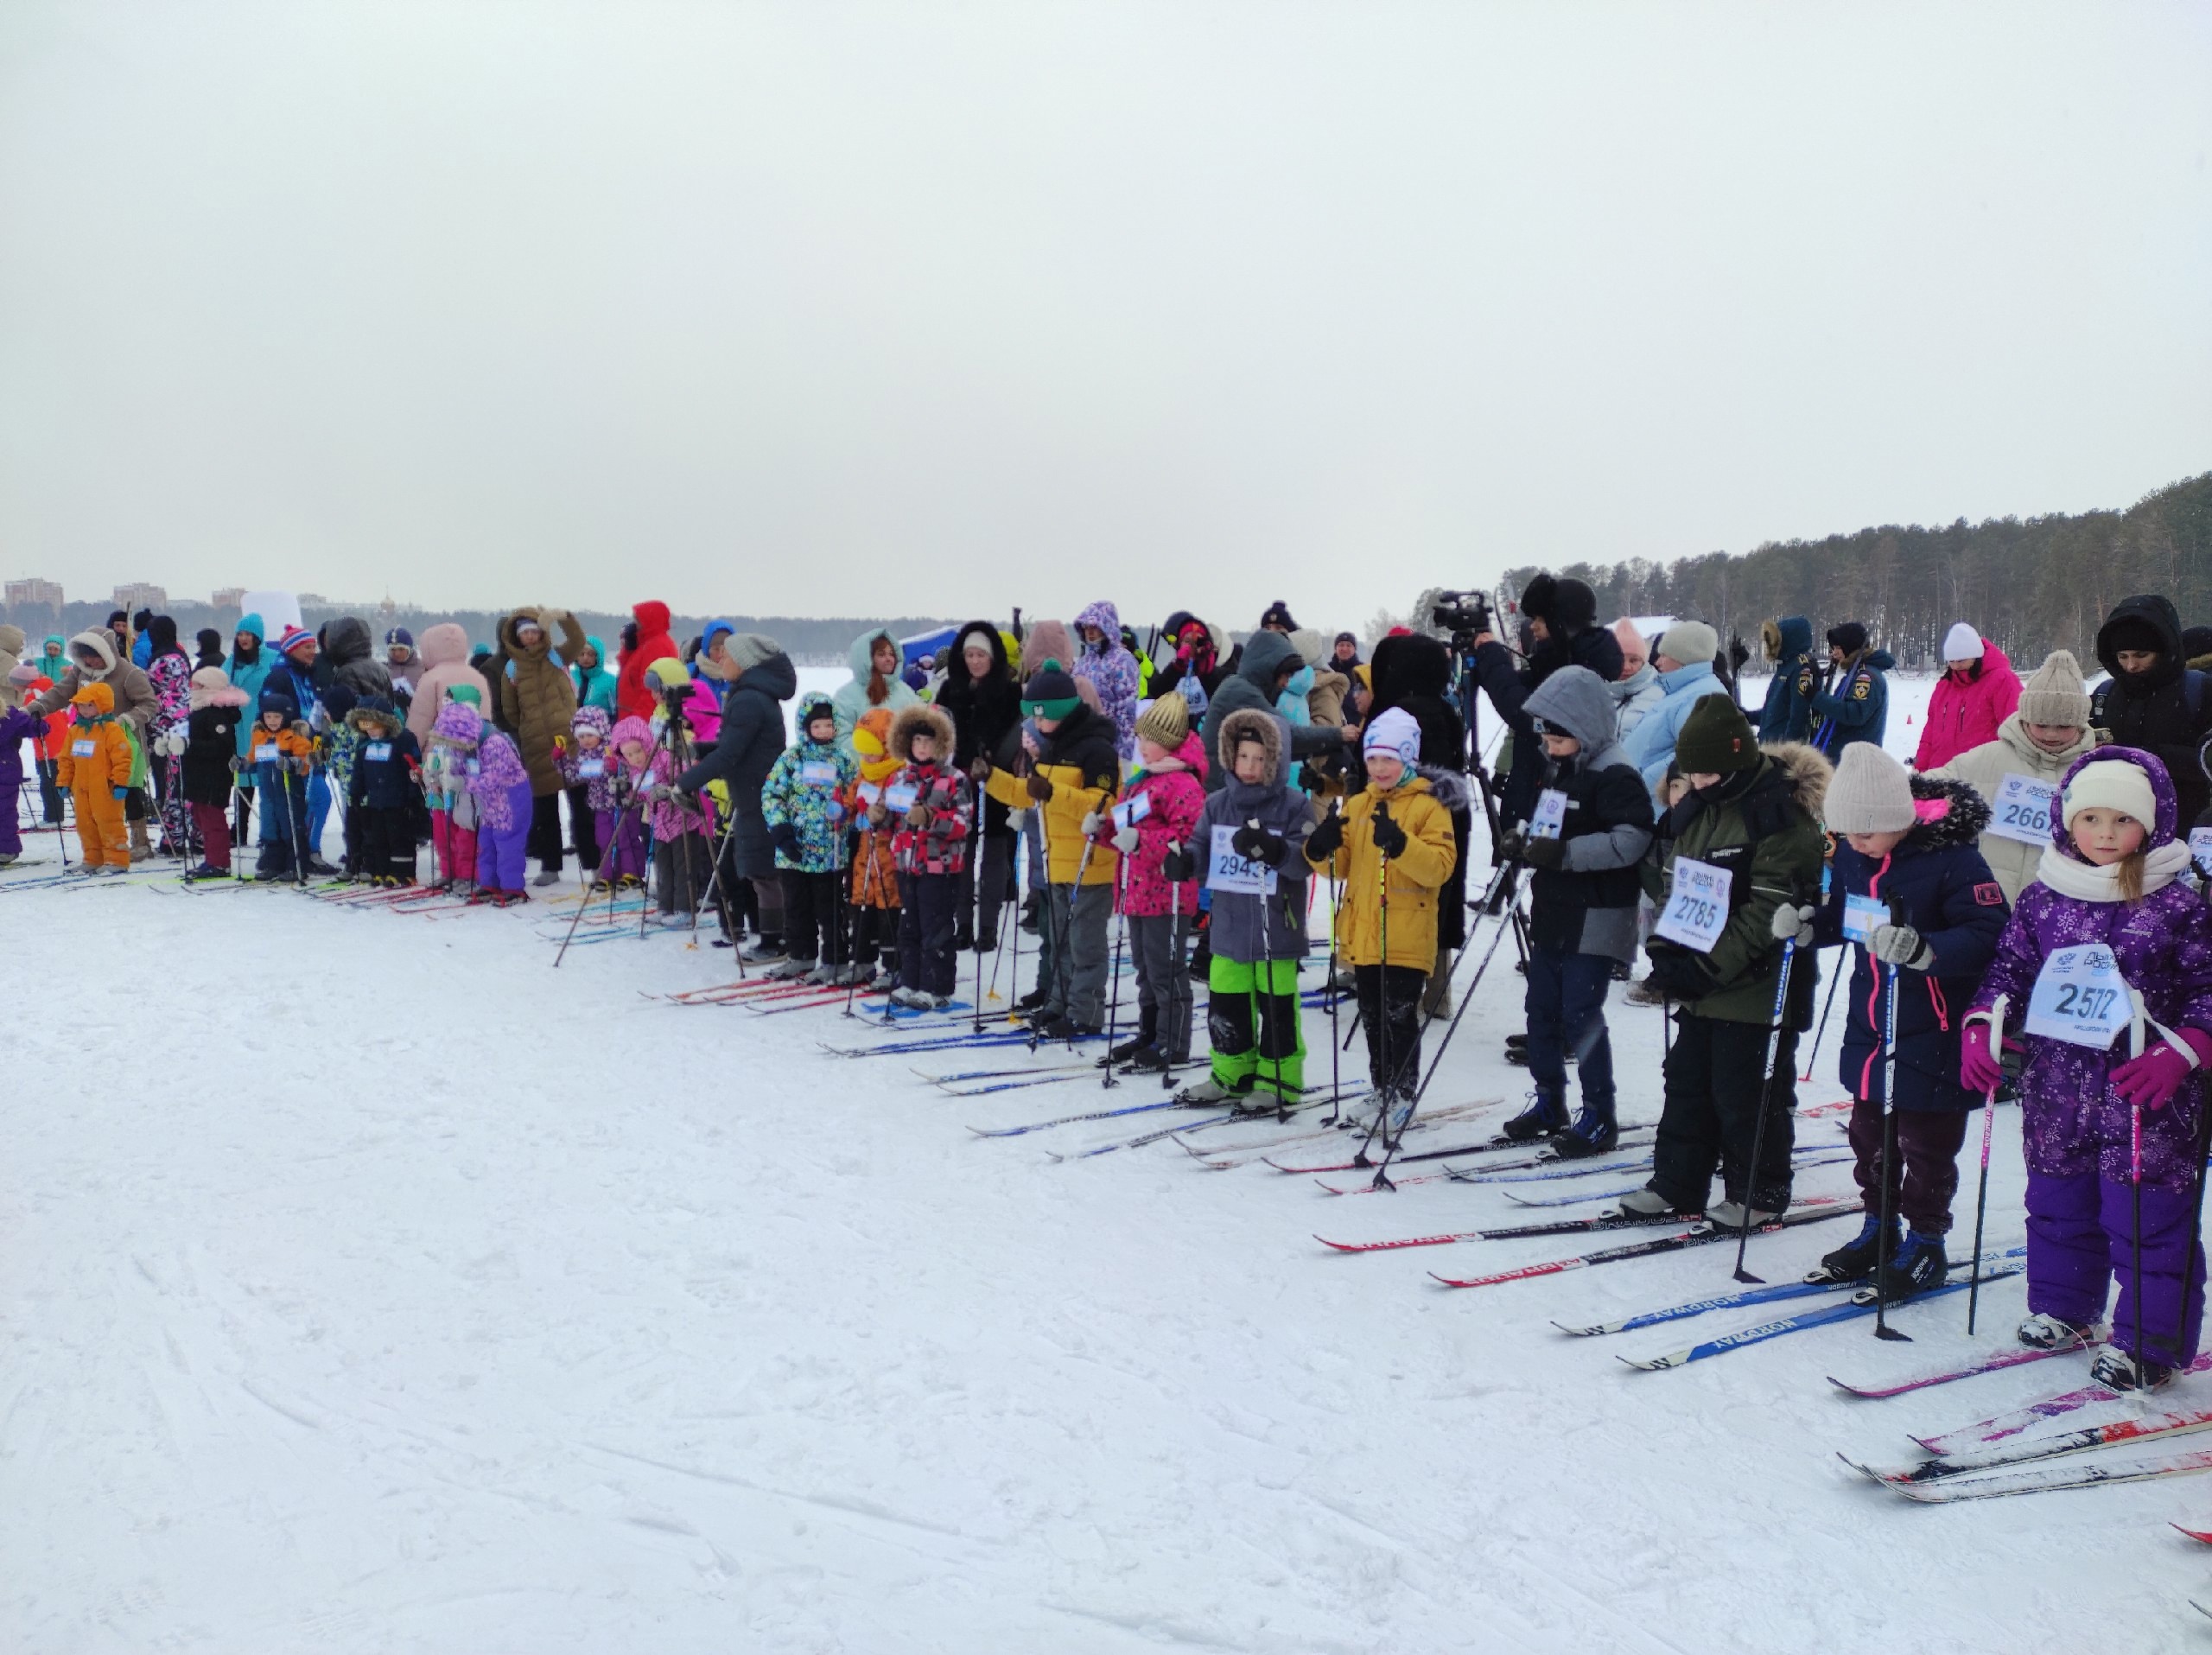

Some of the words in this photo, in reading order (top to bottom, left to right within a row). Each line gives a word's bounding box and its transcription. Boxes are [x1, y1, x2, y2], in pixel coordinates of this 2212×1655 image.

[1674, 895, 1718, 929] 2785
[2055, 983, 2119, 1020] 2572
[1984, 1110, 1993, 1148] NORDWAY
[1910, 1256, 1929, 1279] NORDWAY
[1827, 1281, 1858, 1291] NORDWAY
[1655, 1295, 1742, 1320] NORDWAY
[1713, 1319, 1798, 1349] NORDWAY
